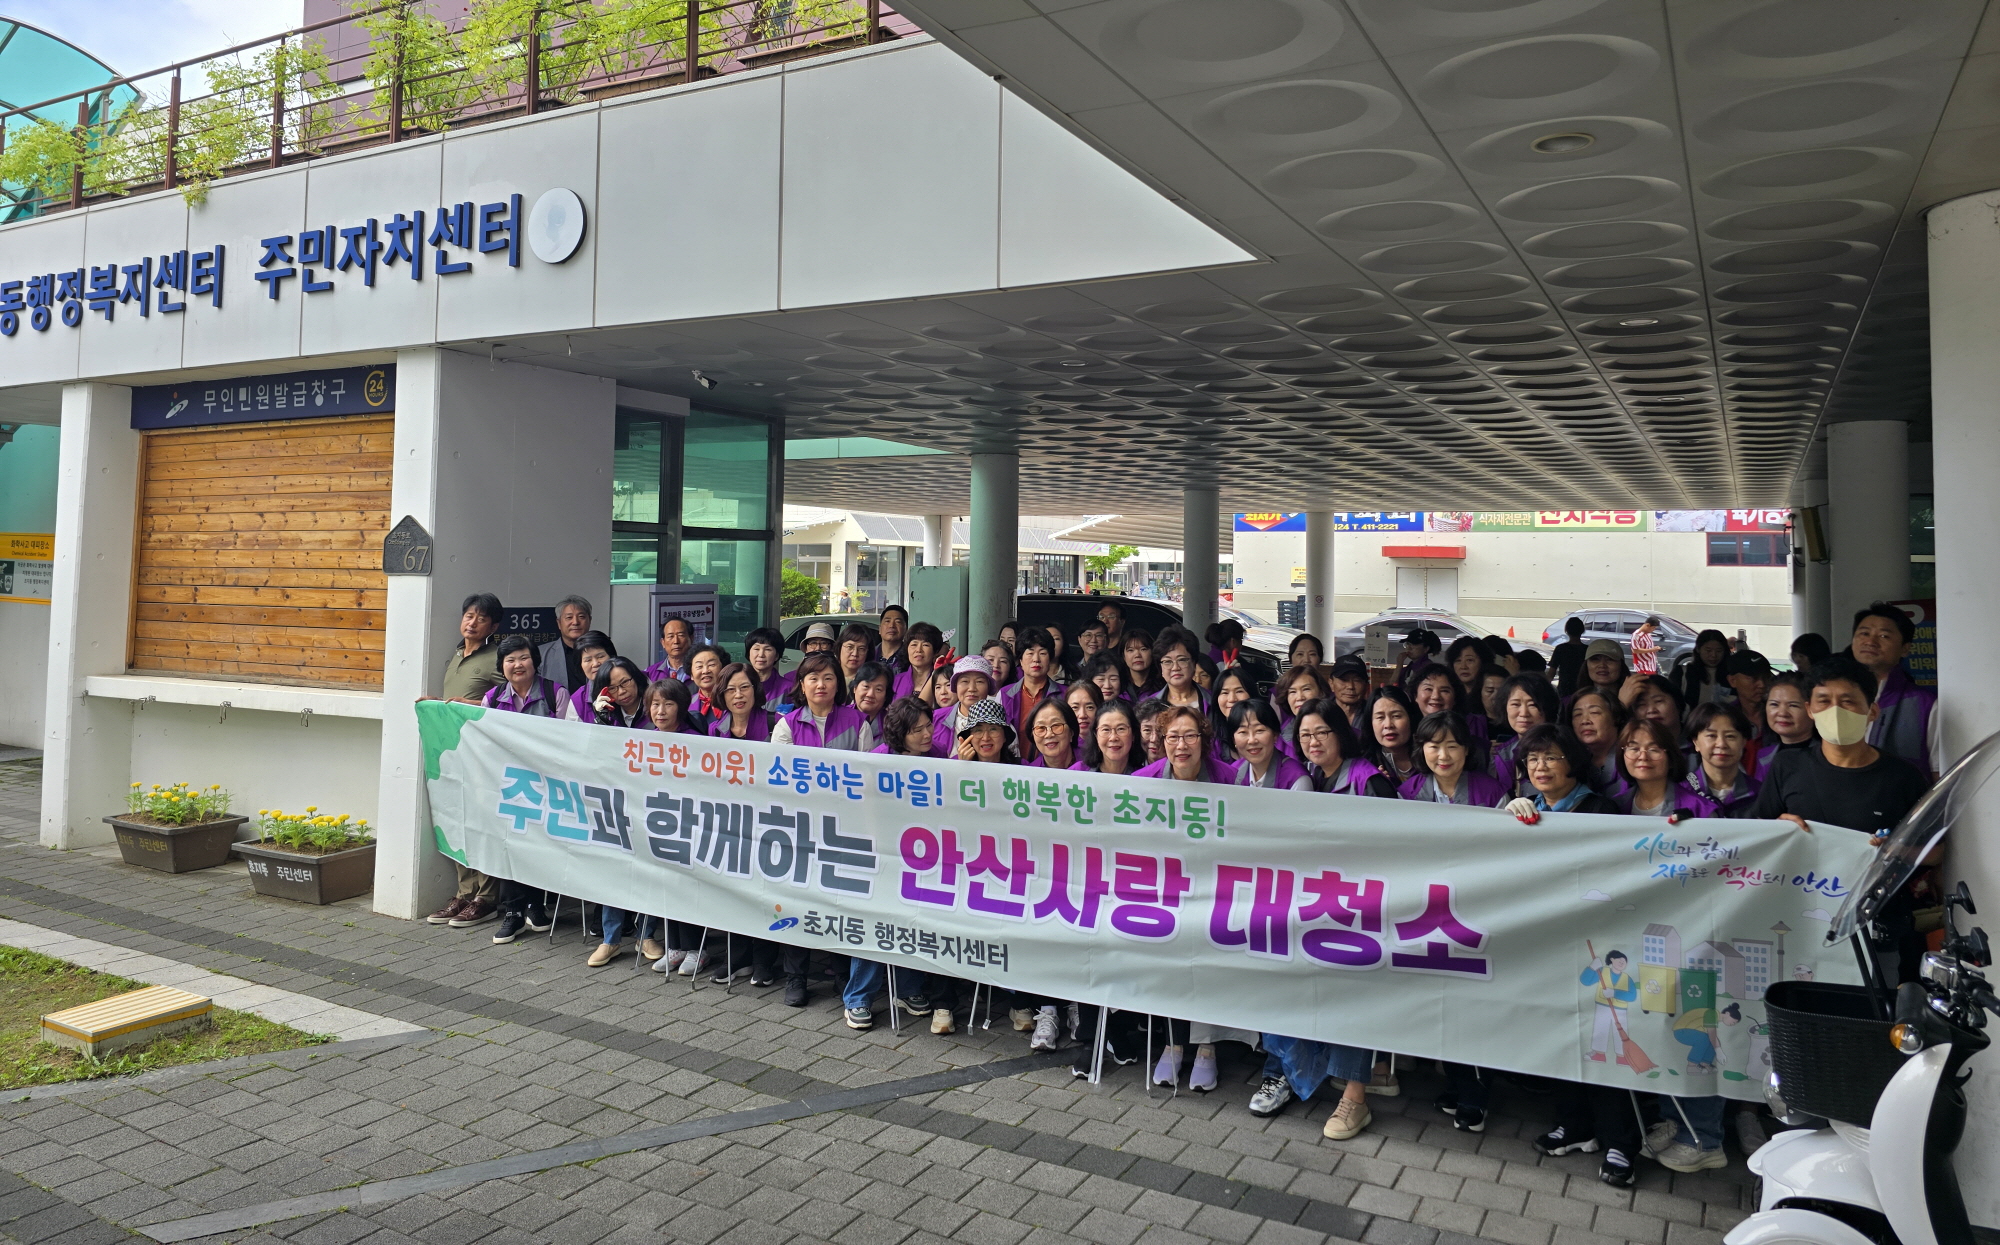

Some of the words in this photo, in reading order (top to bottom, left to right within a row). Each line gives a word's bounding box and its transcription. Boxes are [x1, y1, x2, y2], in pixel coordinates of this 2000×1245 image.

[0, 244, 224, 336] 동행정복지센터
[255, 193, 523, 299] 주민자치센터
[202, 378, 347, 414] 무인민원발급창구
[369, 379, 384, 392] 24
[1479, 513, 1531, 526] 식자재전문관
[403, 545, 429, 571] 67
[509, 613, 541, 630] 365
[624, 740, 689, 778] 친근한
[701, 751, 755, 785] 이웃!
[767, 755, 864, 800] 소통하는
[878, 770, 943, 808] 마을!
[960, 780, 986, 808] 더
[1003, 778, 1097, 825] 행복한
[1114, 791, 1226, 839] 초지동!
[1633, 833, 1696, 864] 시민과
[248, 860, 269, 877] 초지동
[276, 866, 313, 882] 주민센터
[499, 766, 632, 851] 주민과
[646, 791, 873, 892] 함께하는
[901, 826, 1190, 937] 안산사랑
[1209, 865, 1487, 974] 대청소
[1651, 863, 1711, 888] 자유로운
[1716, 864, 1786, 890] 혁신도시
[1791, 871, 1850, 898] 안산
[803, 910, 866, 939] 초지동
[875, 922, 1009, 972] 행정복지센터
